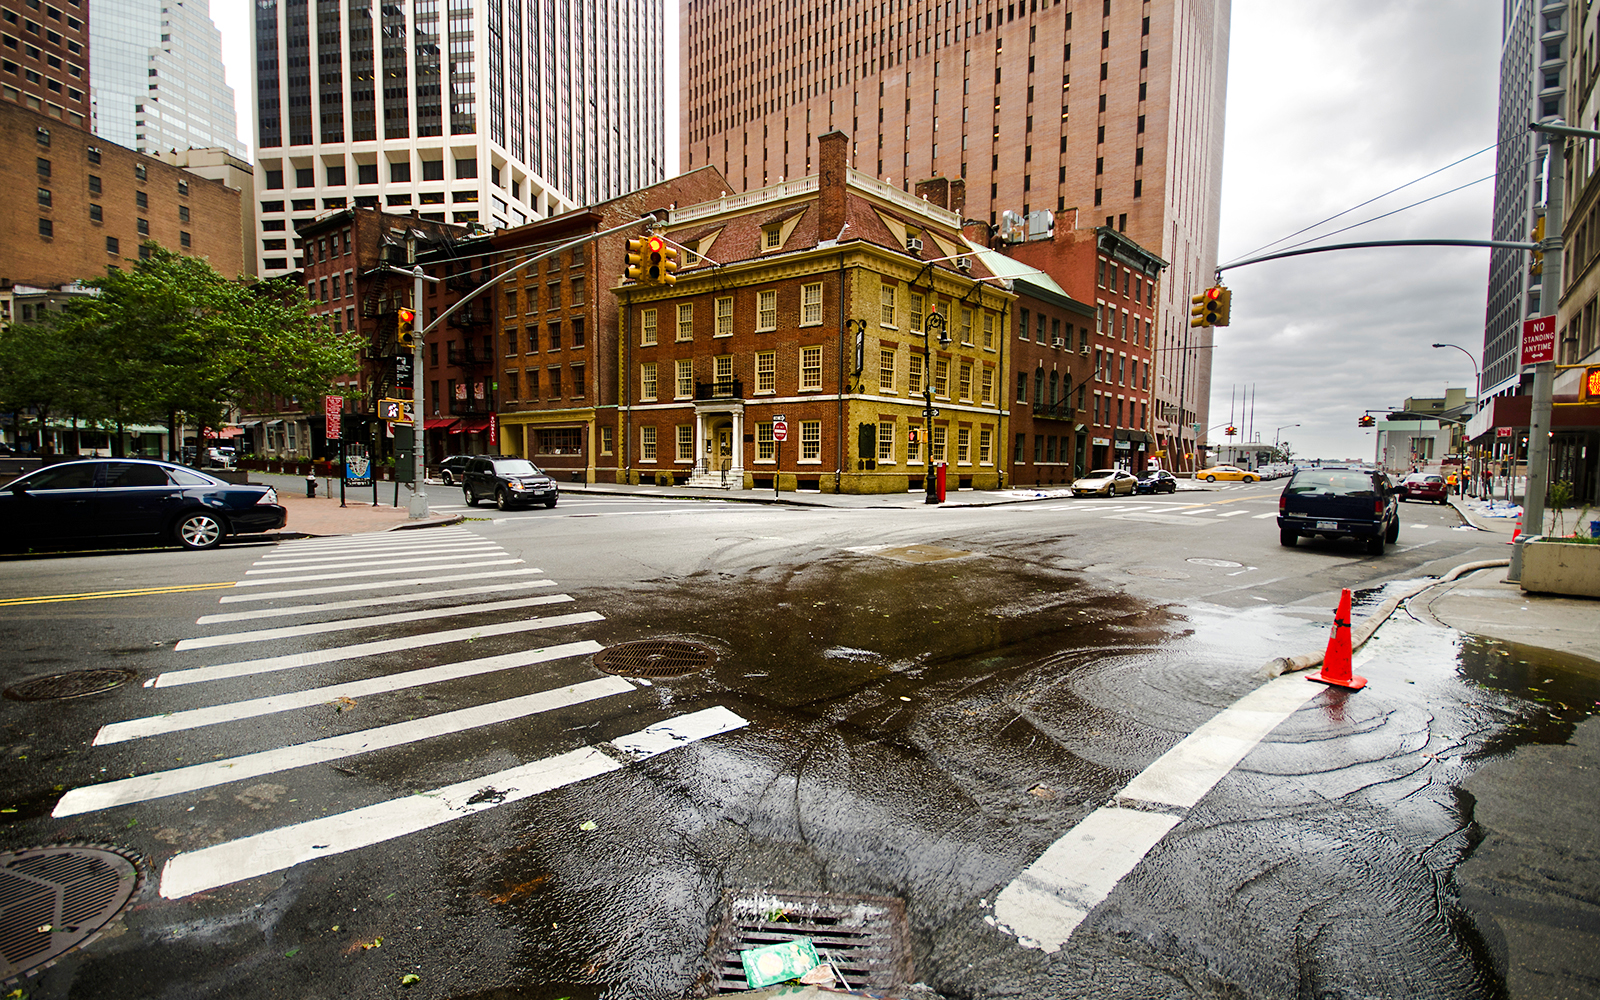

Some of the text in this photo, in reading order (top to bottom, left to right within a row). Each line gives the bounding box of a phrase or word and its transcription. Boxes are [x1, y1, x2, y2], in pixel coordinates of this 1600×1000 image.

[1533, 322, 1545, 333] NO
[1523, 332, 1555, 344] STANDING
[1524, 342, 1552, 353] ANYTIME
